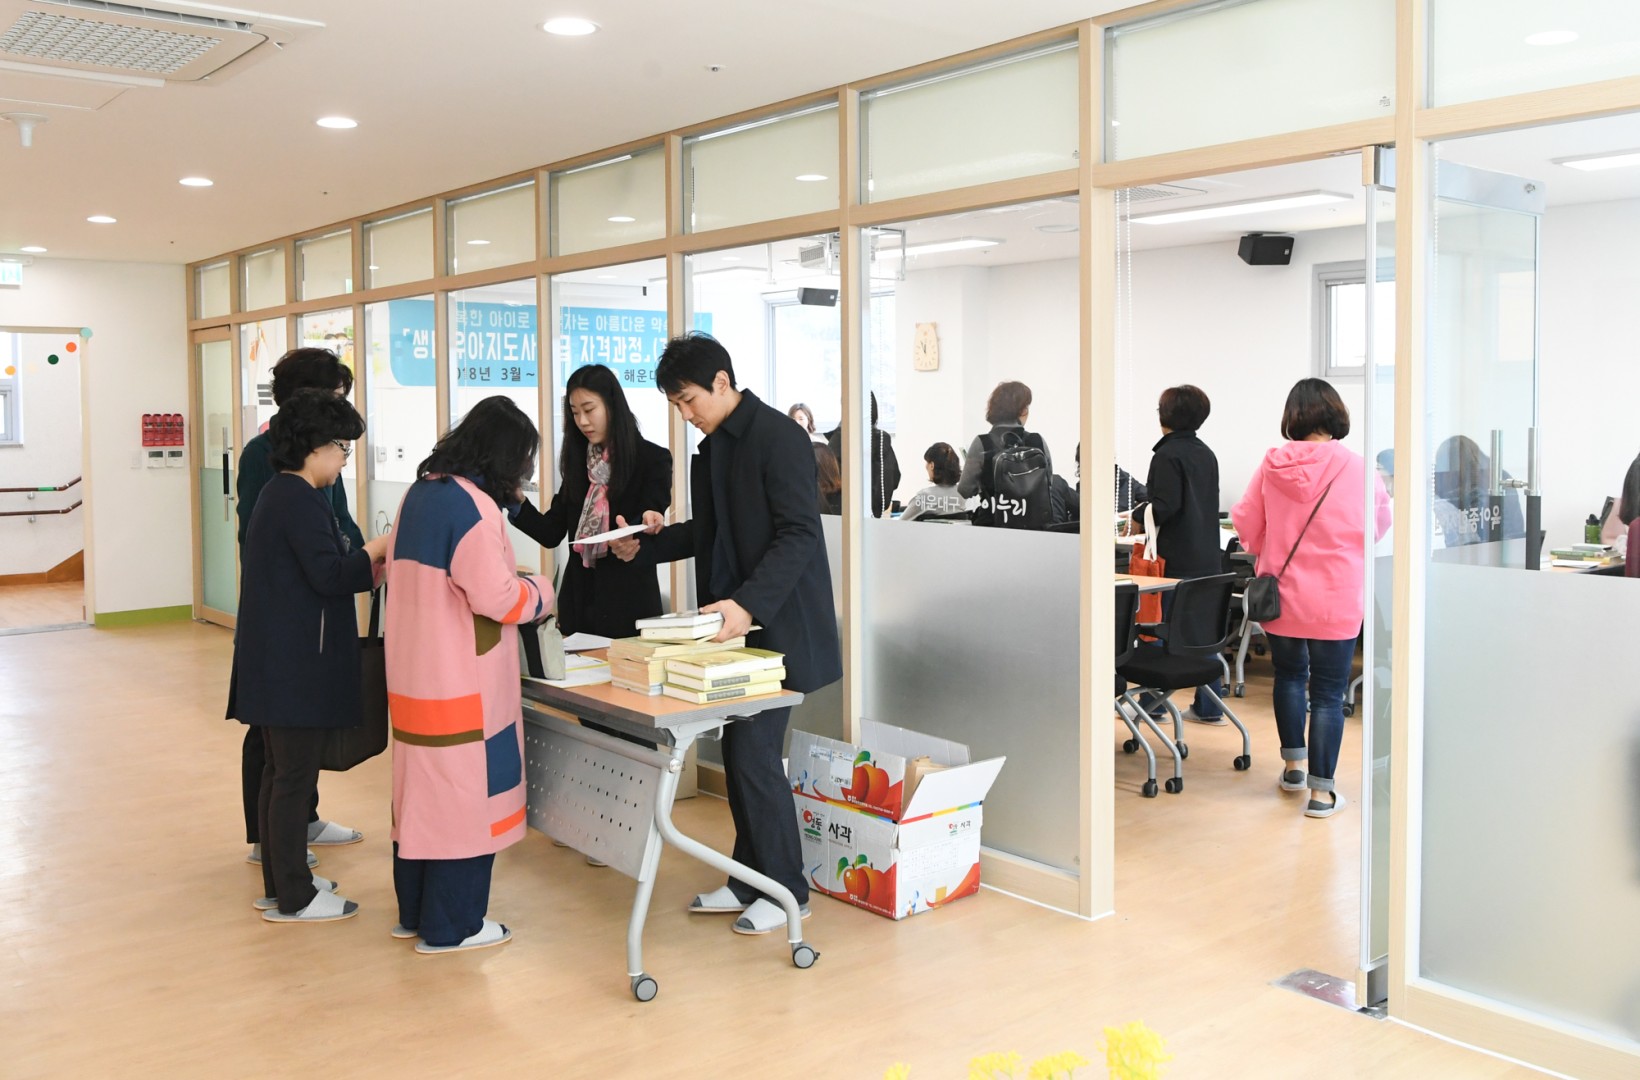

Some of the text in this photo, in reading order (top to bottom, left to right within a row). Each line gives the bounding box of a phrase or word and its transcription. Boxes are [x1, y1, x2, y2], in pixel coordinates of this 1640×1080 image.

[489, 310, 530, 329] 아이로
[595, 314, 645, 333] 아름다운
[501, 366, 521, 382] 3월
[915, 494, 960, 513] 해운대구
[828, 822, 852, 843] 사과
